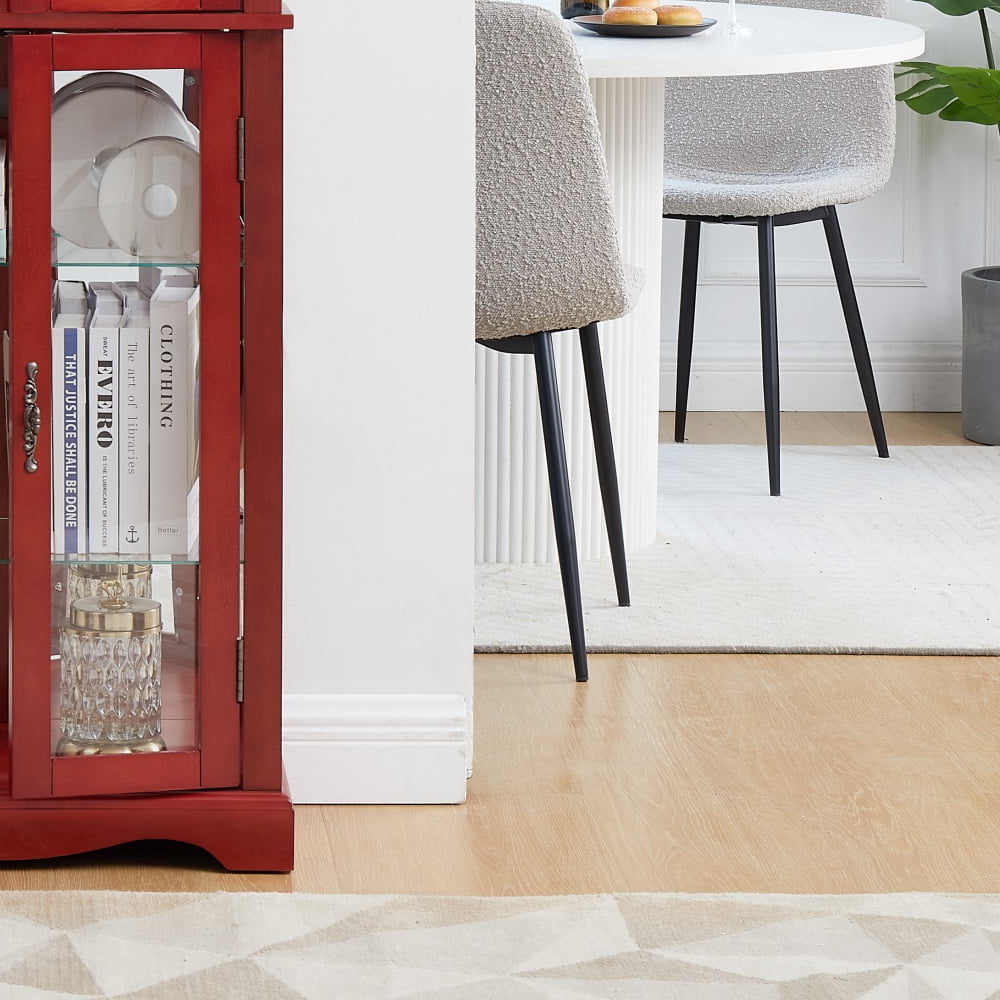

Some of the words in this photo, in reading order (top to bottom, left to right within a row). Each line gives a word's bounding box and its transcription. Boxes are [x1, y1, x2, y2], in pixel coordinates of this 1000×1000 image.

[127, 342, 138, 362] The
[65, 354, 76, 385] THAT
[127, 368, 137, 388] art
[160, 324, 173, 428] CLOTHING
[65, 389, 76, 438] JUSTICE
[97, 359, 113, 449] EVERO
[127, 395, 138, 409] of
[65, 442, 76, 477] SHALL
[127, 416, 138, 475] libraries
[65, 480, 77, 494] BE
[65, 496, 77, 528] DONE
